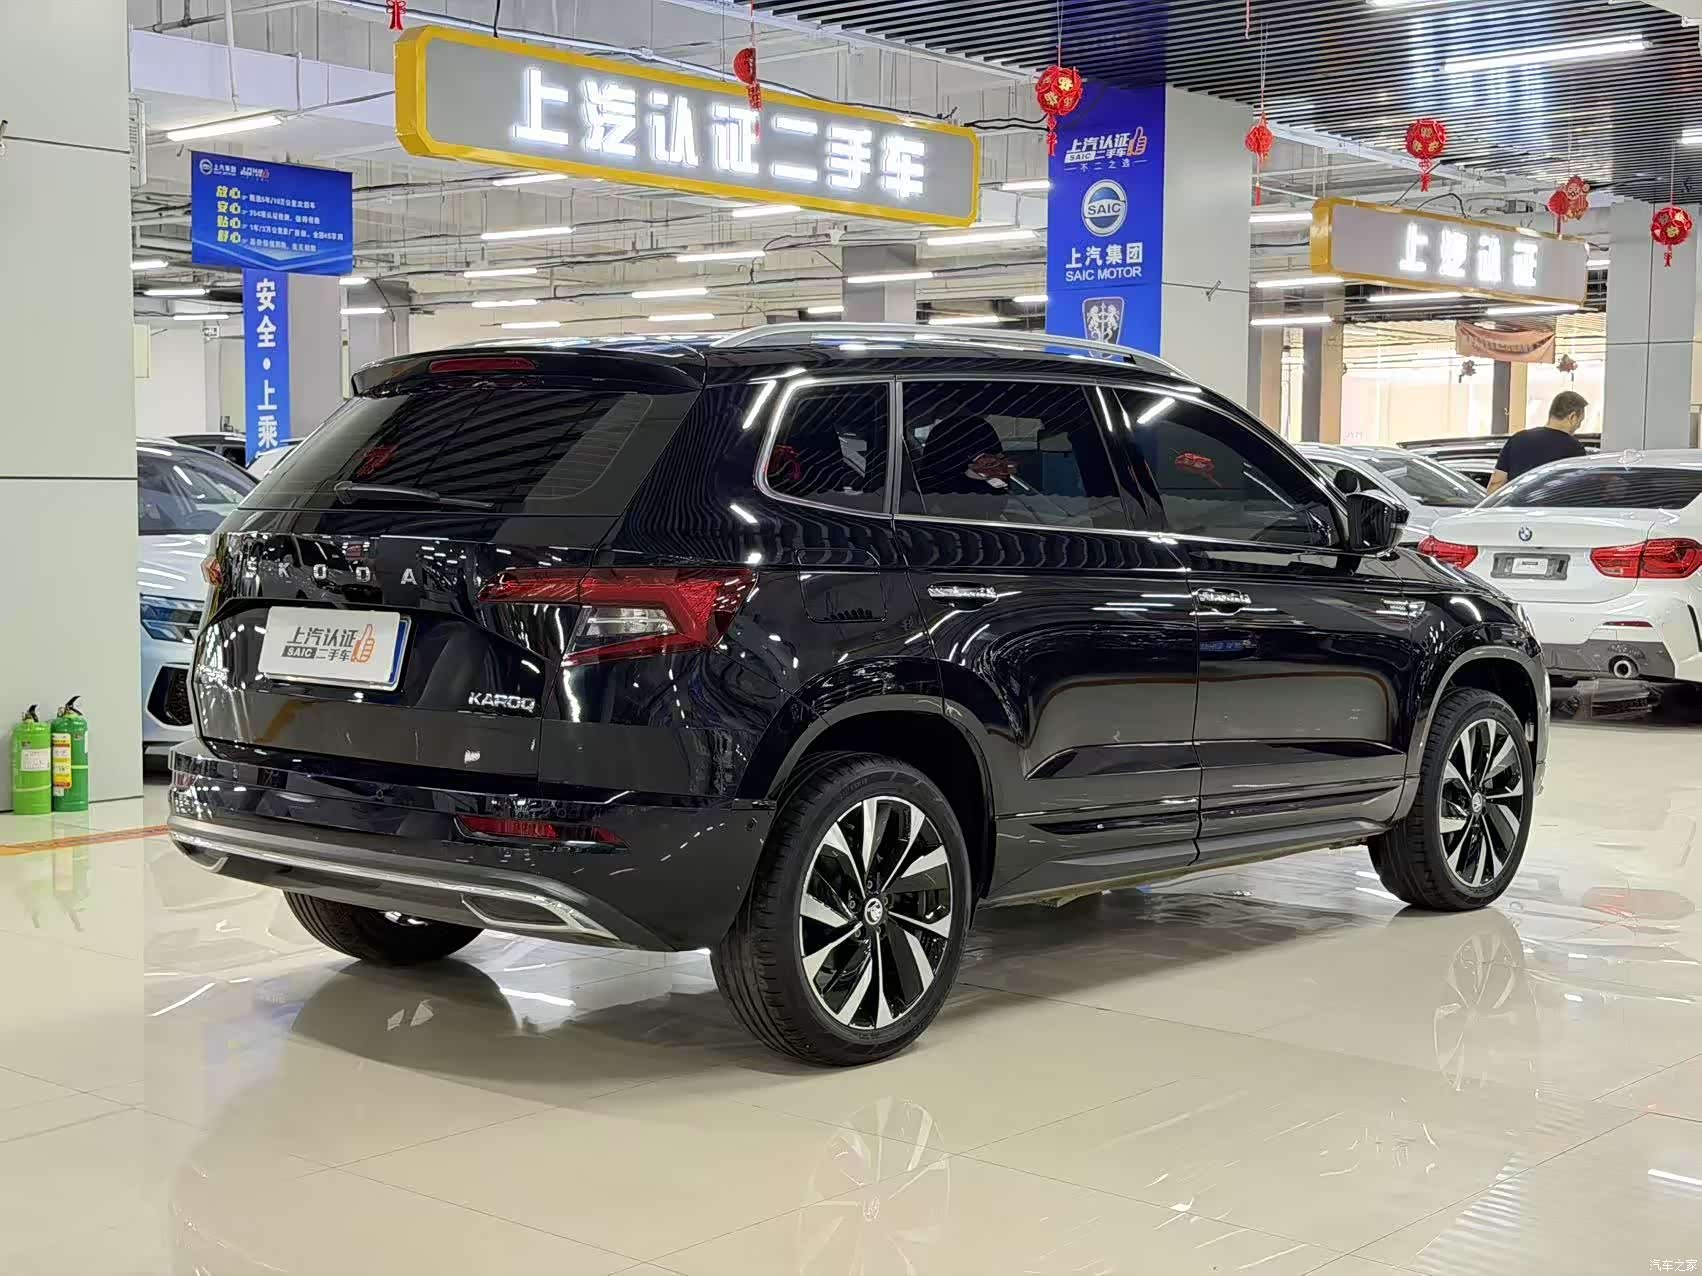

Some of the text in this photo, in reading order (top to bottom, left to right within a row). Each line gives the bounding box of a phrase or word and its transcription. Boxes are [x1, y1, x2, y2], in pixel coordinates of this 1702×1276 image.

[513, 67, 927, 199] 上汽认证二手车
[1066, 133, 1131, 153] 上汽认证
[1069, 153, 1091, 162] SAIC
[217, 201, 241, 214] 安心
[1087, 202, 1122, 216] SAIC
[1066, 242, 1143, 269] 上汽集团
[1398, 221, 1539, 287] 上汽认证
[1066, 266, 1142, 282] SAIC MOTOR
[255, 278, 278, 457] 安全·上乘
[286, 626, 359, 647] 上汽认证
[287, 647, 352, 661] SAIC 二手车
[468, 691, 536, 713] KAROQ
